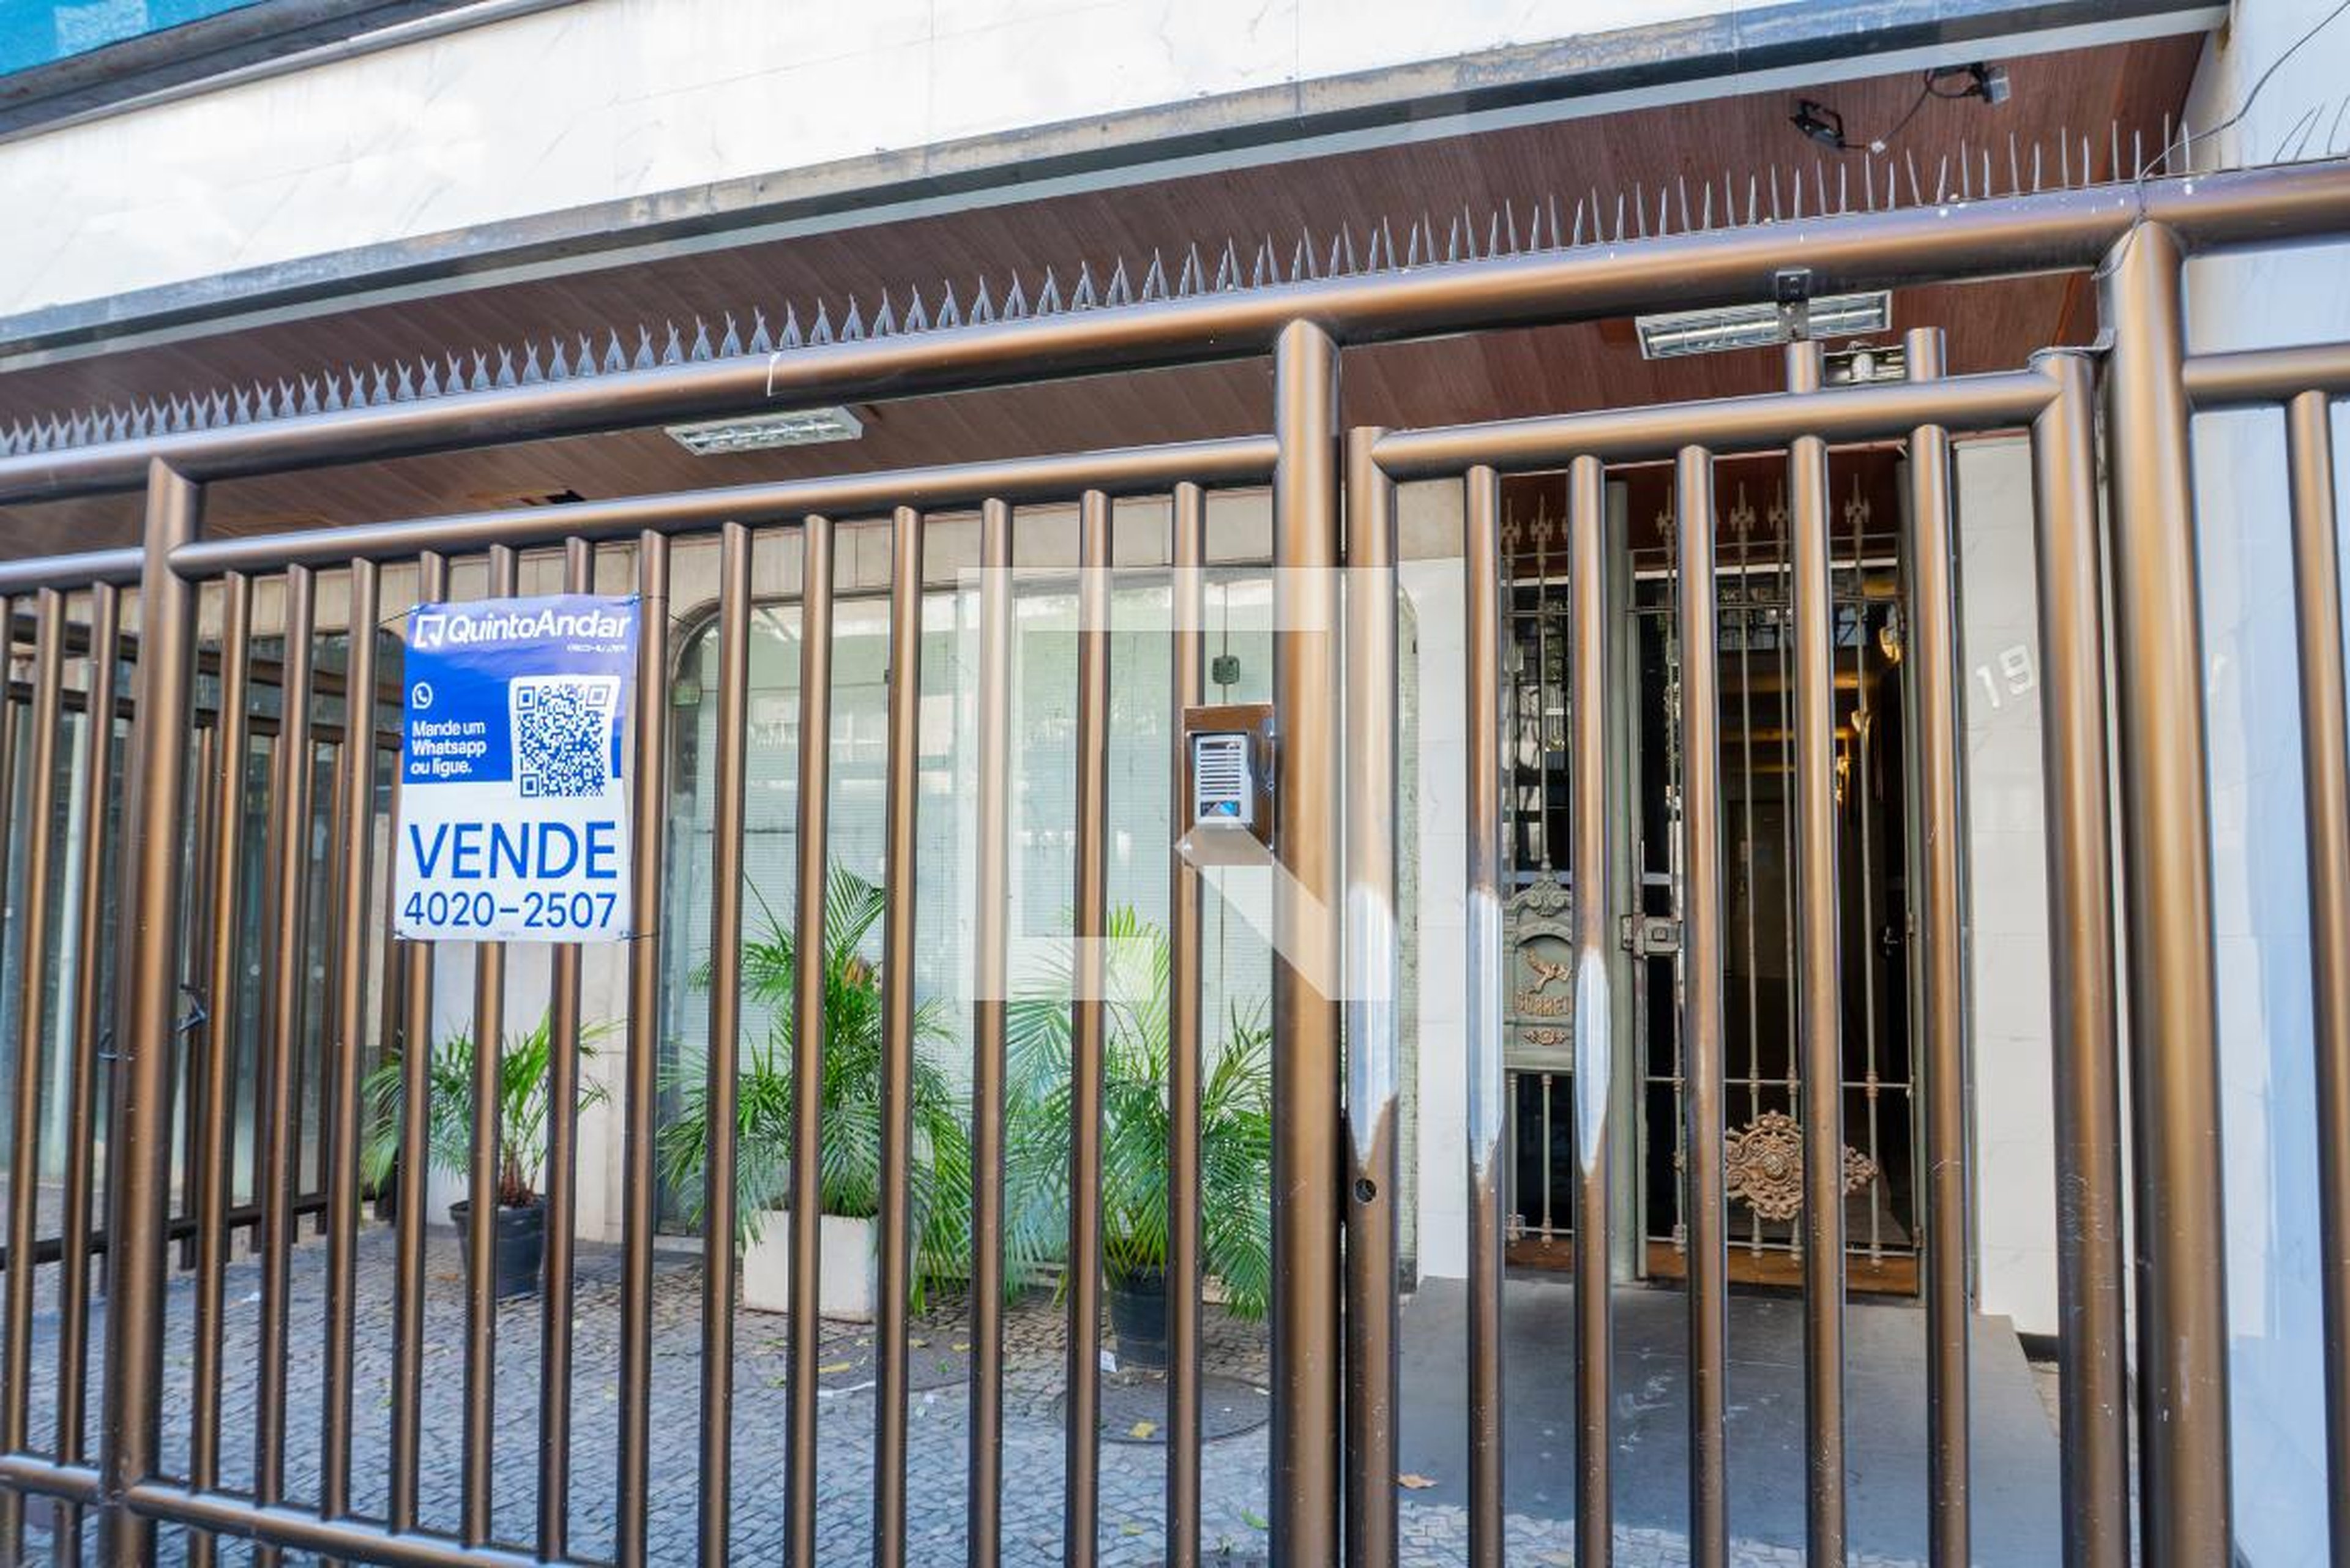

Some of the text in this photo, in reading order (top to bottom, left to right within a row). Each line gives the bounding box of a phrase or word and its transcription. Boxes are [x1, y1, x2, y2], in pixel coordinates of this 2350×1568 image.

[448, 610, 632, 644] QuintoAndar
[1975, 644, 2032, 707] 19
[412, 720, 485, 737] Mande um
[411, 737, 487, 758] Whatsapp
[411, 757, 472, 778] ou ligue.
[409, 821, 617, 878] VENDE
[404, 891, 617, 928] 4020-2507
